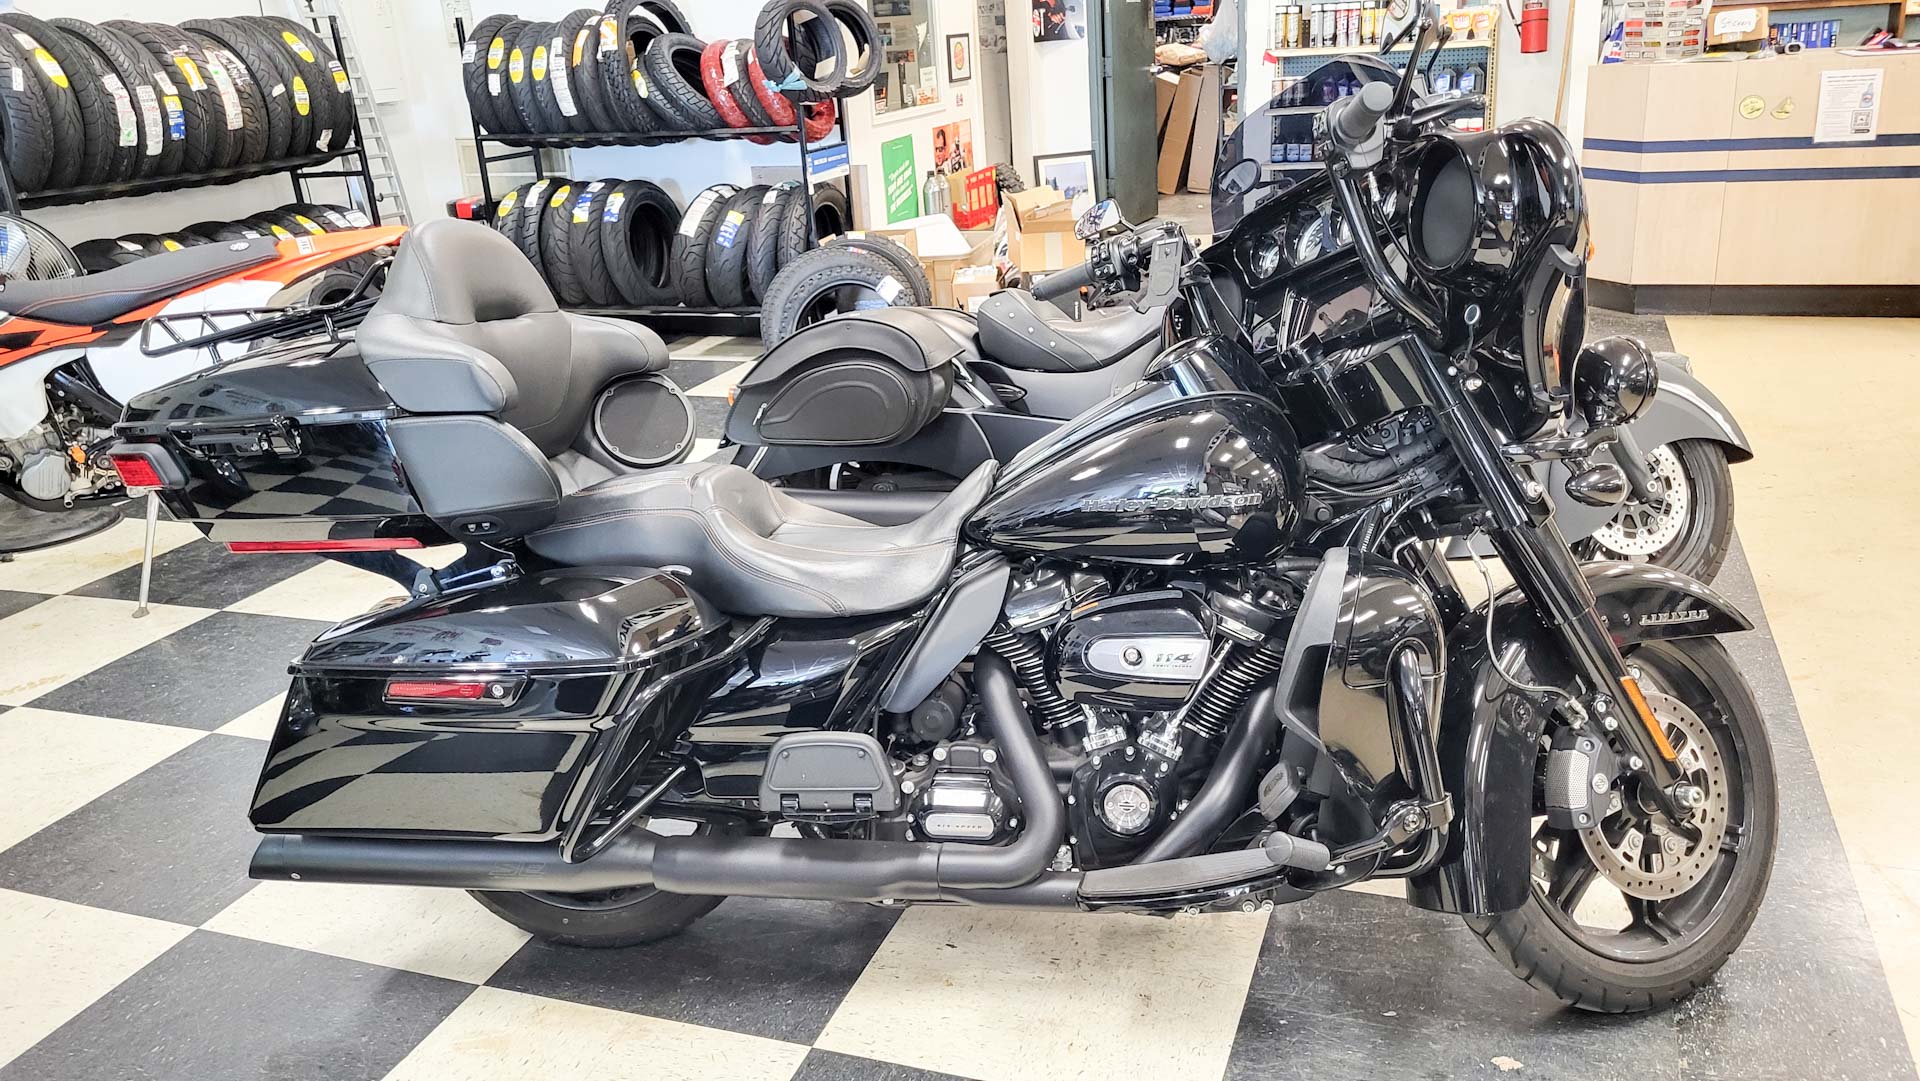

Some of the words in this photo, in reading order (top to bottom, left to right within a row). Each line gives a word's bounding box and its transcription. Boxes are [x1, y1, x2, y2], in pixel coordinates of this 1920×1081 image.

[1080, 492, 1263, 514] Harley-Davidson
[1638, 609, 1710, 626] LIMITED
[1155, 653, 1194, 663] 114
